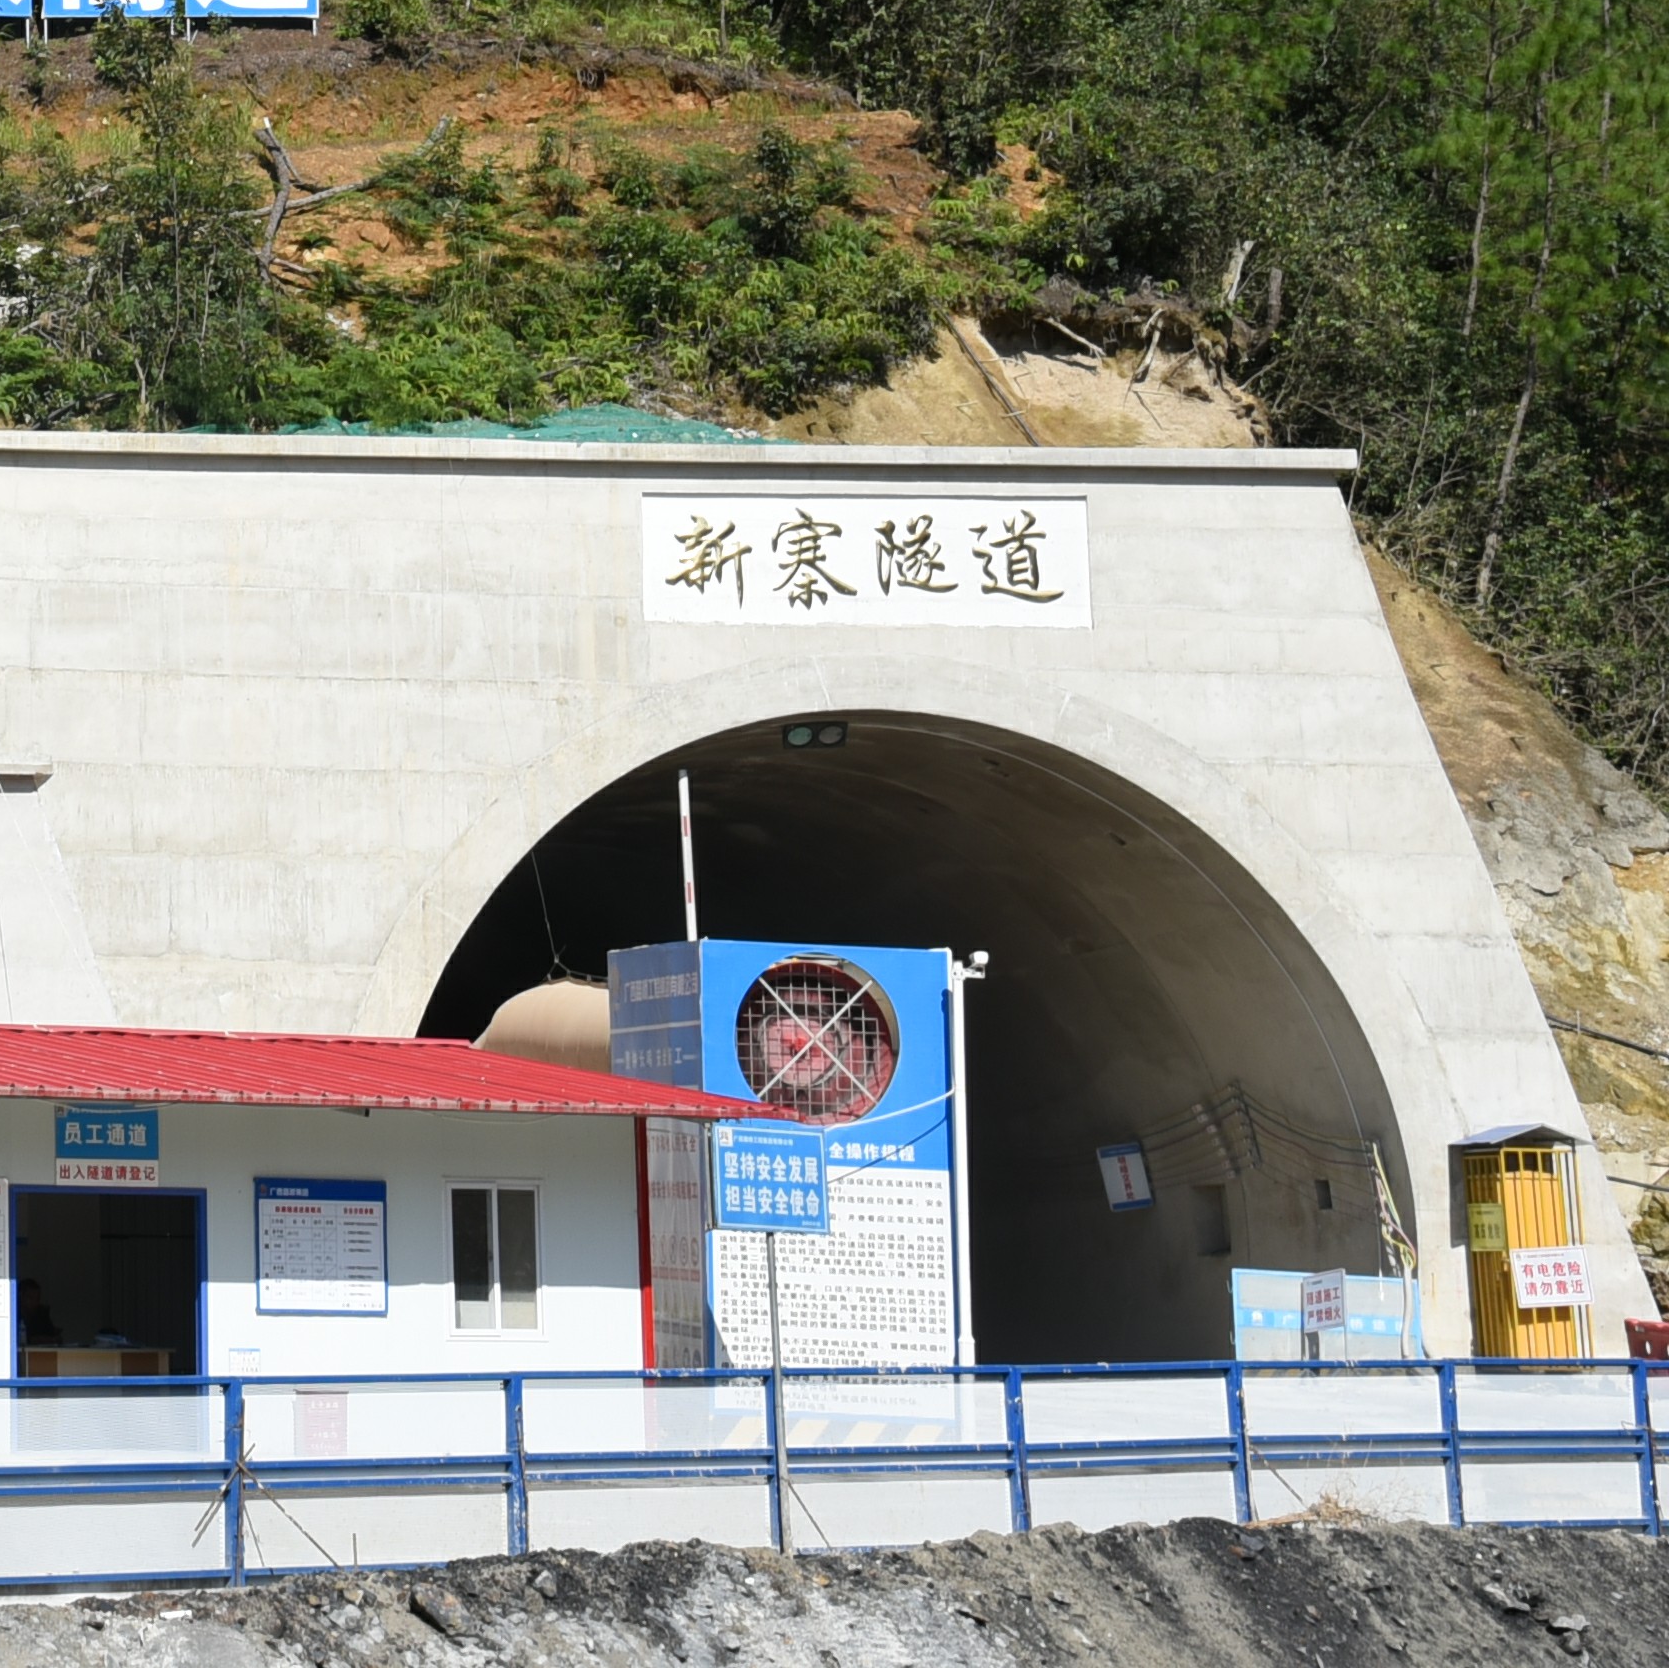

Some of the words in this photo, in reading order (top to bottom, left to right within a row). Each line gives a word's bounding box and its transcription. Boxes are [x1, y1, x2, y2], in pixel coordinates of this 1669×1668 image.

[665, 508, 1065, 610] 新寨隧道
[64, 1122, 147, 1146] 员工通道
[59, 1164, 156, 1181] 出入隧道请登记
[724, 1151, 818, 1184] 坚持安全发展
[725, 1183, 820, 1217] 担当安全使命
[1522, 1261, 1582, 1278] 有电危险
[1306, 1287, 1340, 1306] 隧道施工
[1525, 1279, 1584, 1297] 请勿靠近
[1307, 1306, 1341, 1325] 严禁烟火
